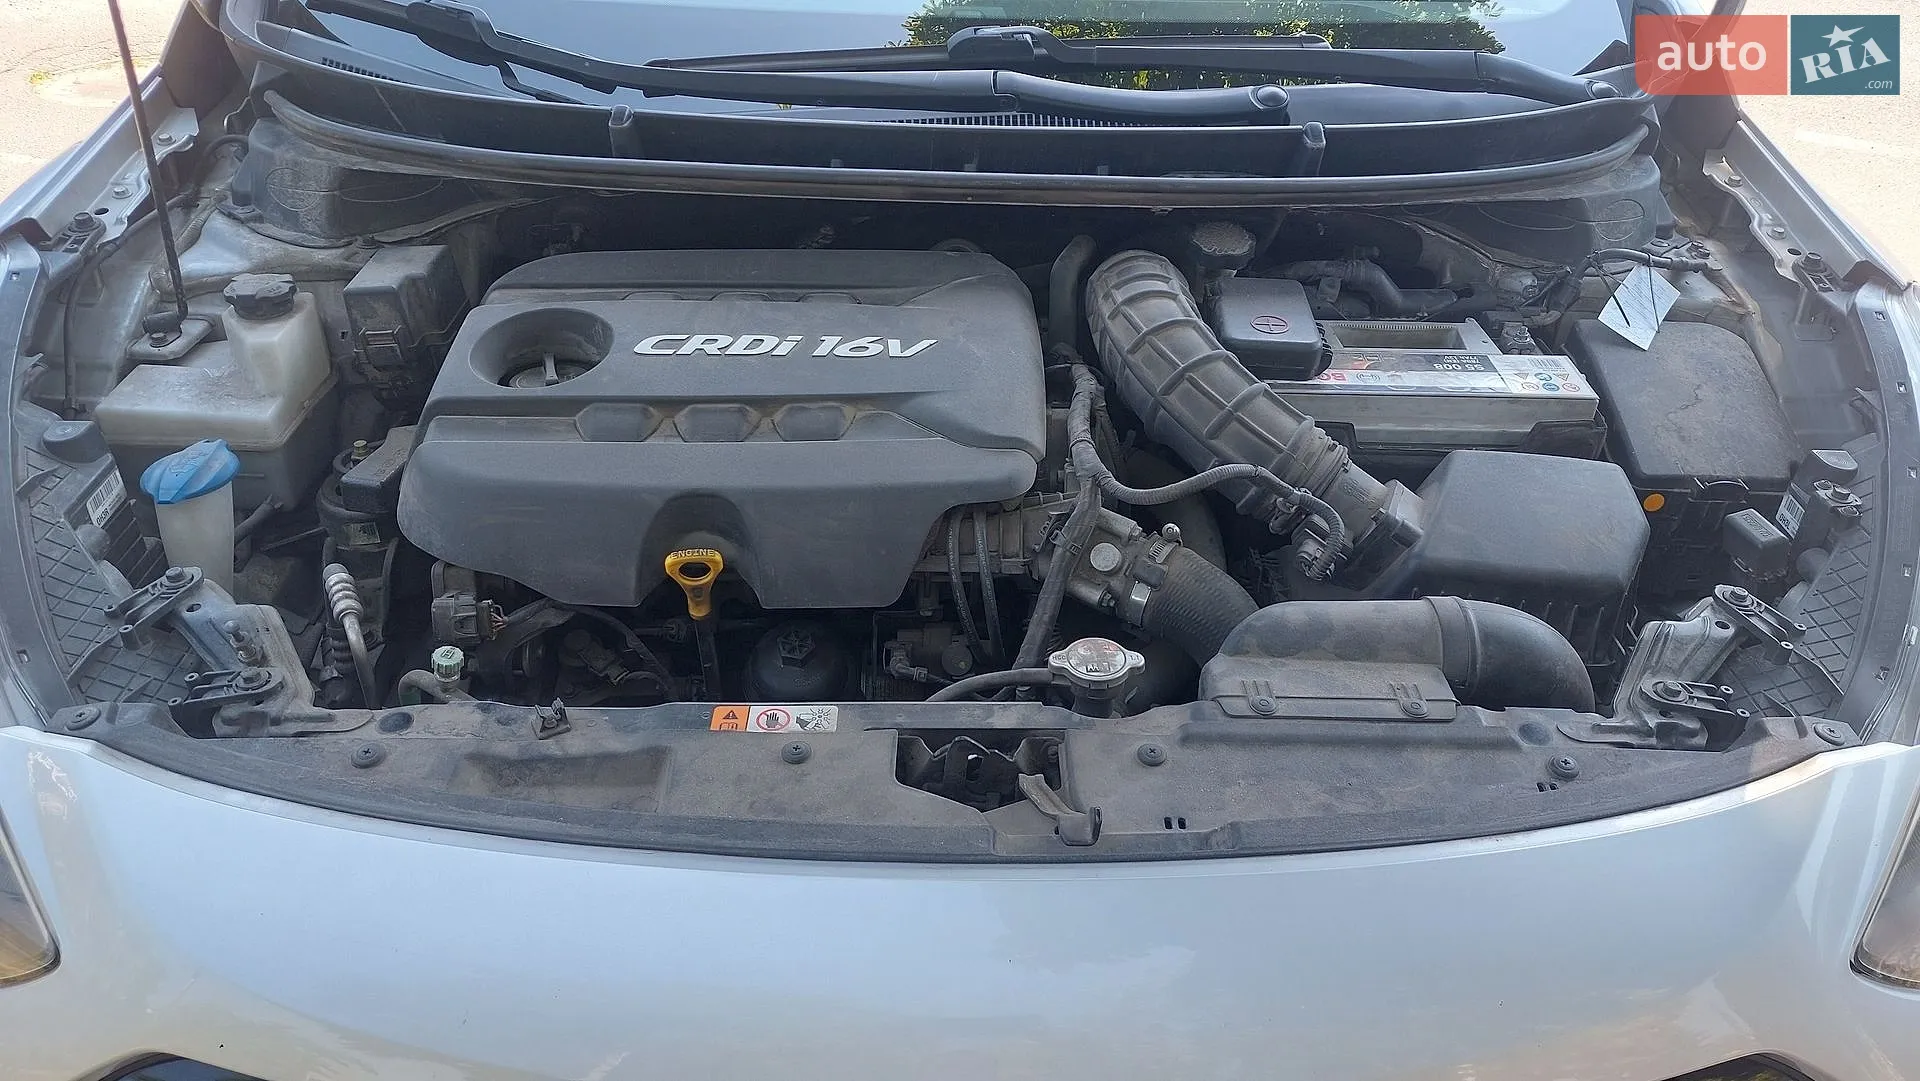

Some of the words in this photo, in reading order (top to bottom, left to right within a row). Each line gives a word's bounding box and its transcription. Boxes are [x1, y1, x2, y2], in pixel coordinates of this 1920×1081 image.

[633, 334, 804, 356] CRDi
[811, 336, 938, 358] 16V
[670, 548, 715, 559] ENGINE
